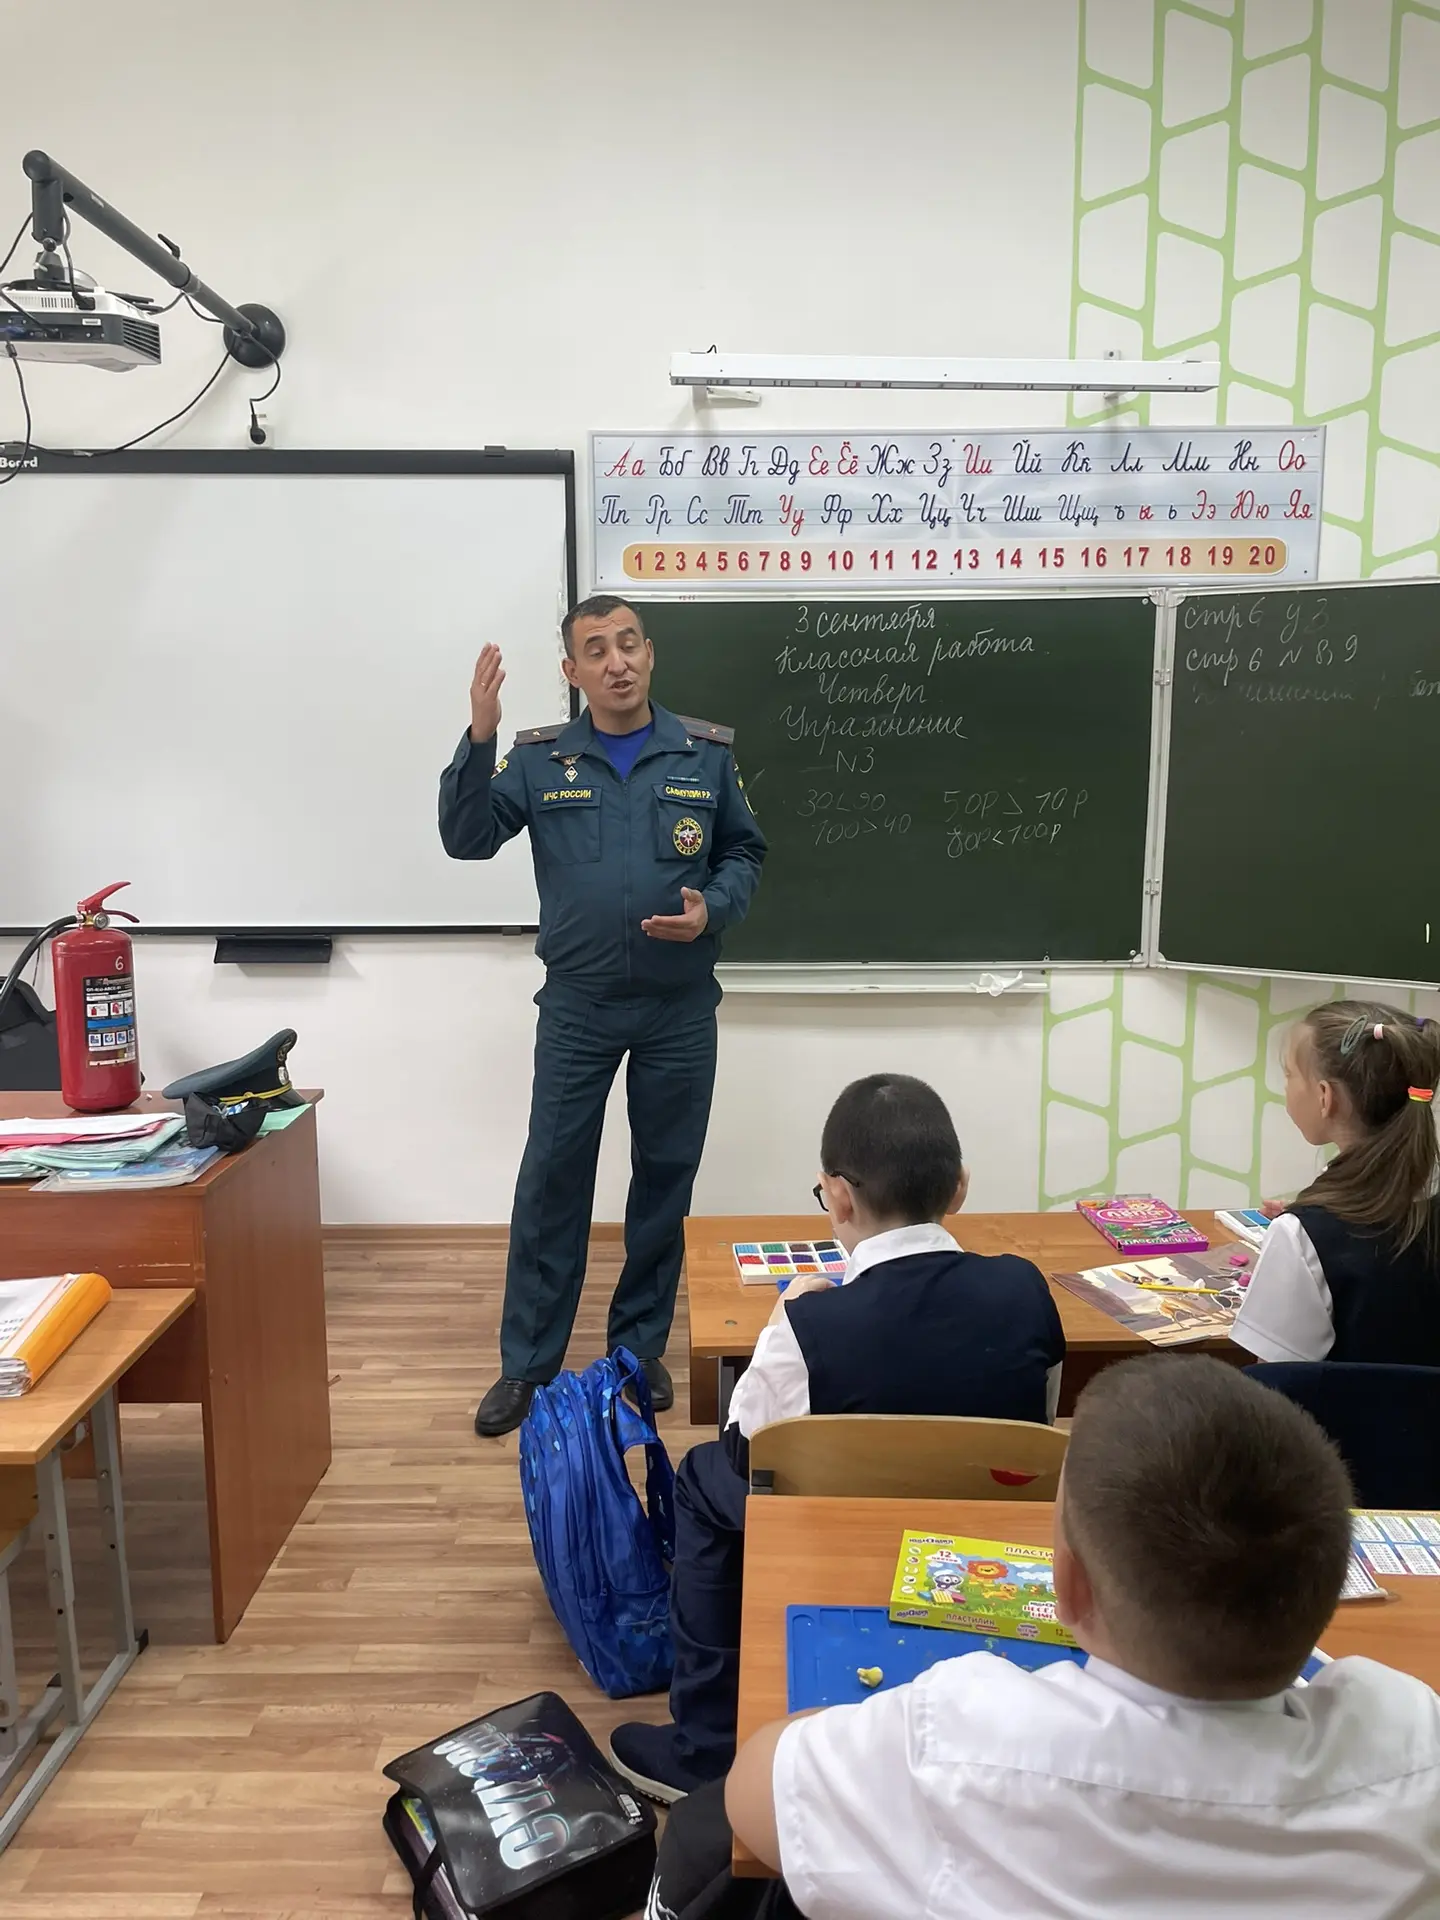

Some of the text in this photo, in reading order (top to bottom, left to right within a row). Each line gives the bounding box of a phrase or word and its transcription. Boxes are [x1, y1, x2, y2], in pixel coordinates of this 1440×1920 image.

[604, 439, 1306, 488] Аа Бб Вв Гг Дд Ее Ёё Жж Зз Ии Йй Кк Лл Мм Нн Оо
[598, 489, 1313, 536] Пп Рр Сс Тт Уу Фф Хх Цц Чч Шш Щщ ъ ы ь Ээ Юю Яя
[634, 545, 1276, 571] 1 2 3 4 5 6 7 8 9 10 11 12 13 14 15 16 17 18 19 20
[795, 605, 809, 633] 3
[927, 628, 1035, 676] работа
[1249, 648, 1264, 672] 6
[1344, 635, 1358, 662] 9
[819, 672, 927, 714] Четверг
[779, 705, 968, 756] Упражнение
[543, 789, 592, 801] МЧС РОССИИ
[115, 955, 124, 970] 6
[939, 1550, 952, 1558] 12
[946, 1613, 995, 1626] ПЛАСТИЛИН
